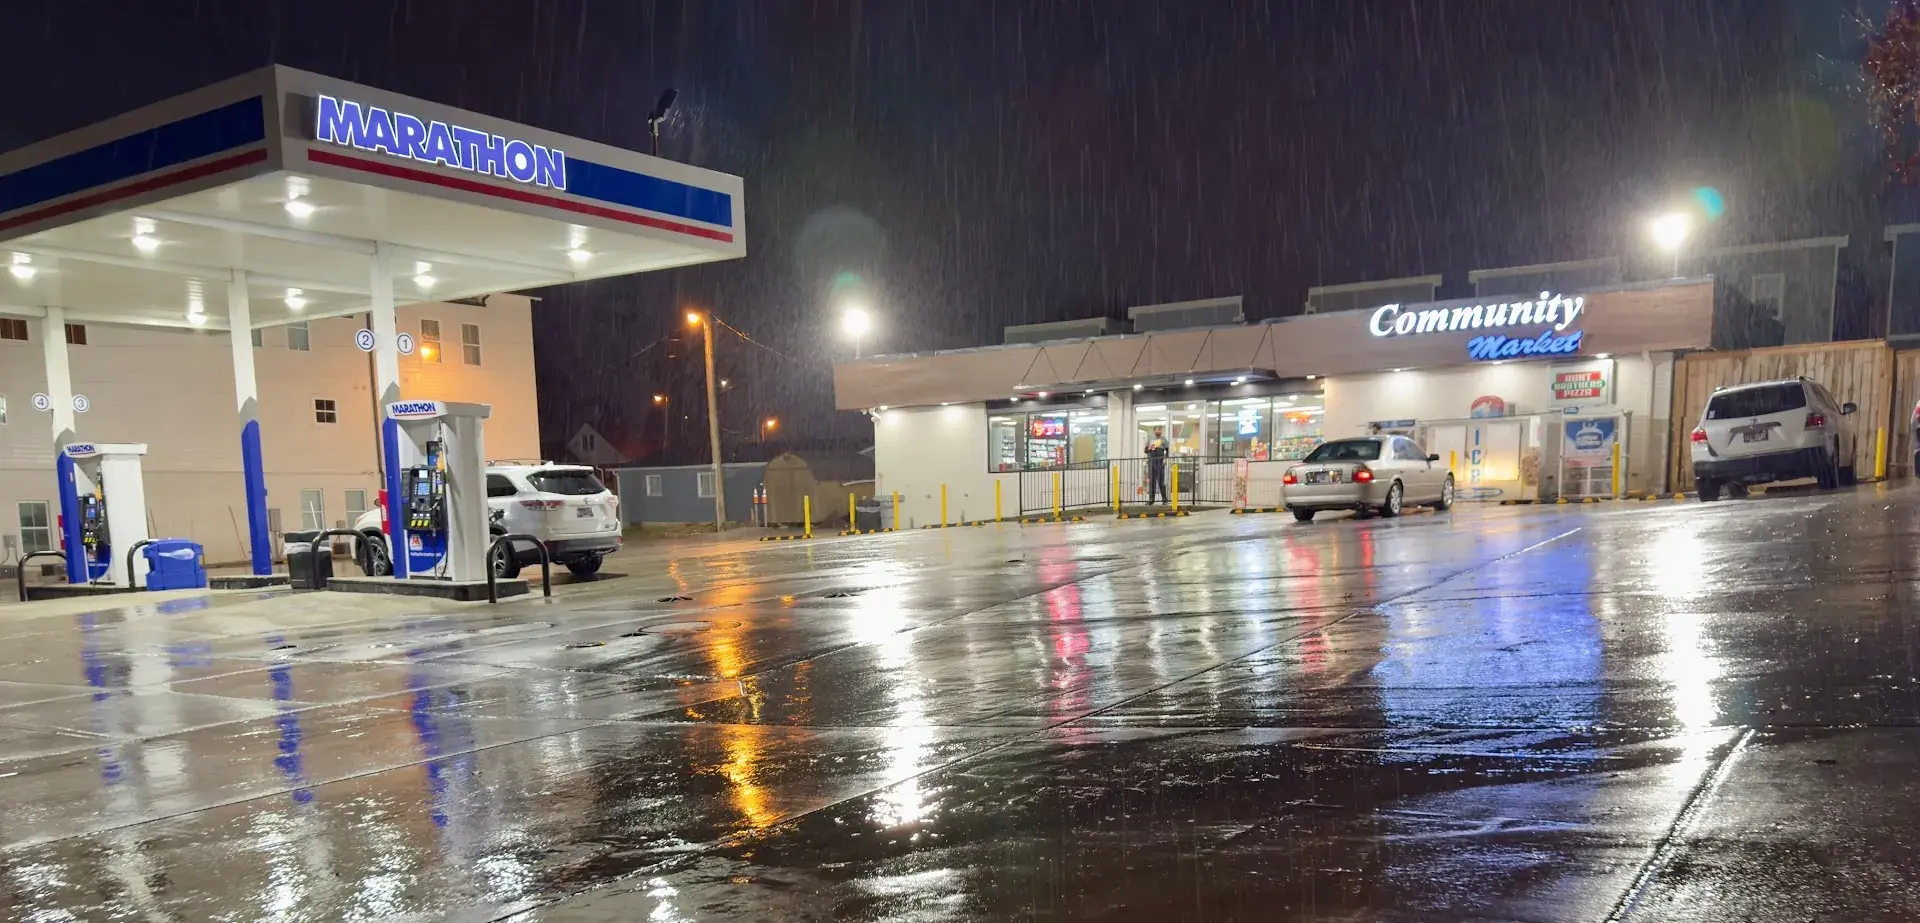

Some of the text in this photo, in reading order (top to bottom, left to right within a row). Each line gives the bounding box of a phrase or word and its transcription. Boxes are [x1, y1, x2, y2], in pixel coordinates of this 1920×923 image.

[317, 95, 566, 190] MARATHON
[1370, 290, 1584, 337] Community
[362, 334, 370, 346] 2
[402, 339, 408, 350] 1
[1467, 329, 1583, 361] Market
[1563, 388, 1592, 398] PIZZA
[37, 398, 45, 406] 4
[77, 399, 85, 408] 3
[392, 403, 436, 413] MARATHON
[66, 444, 95, 453] MARATHON
